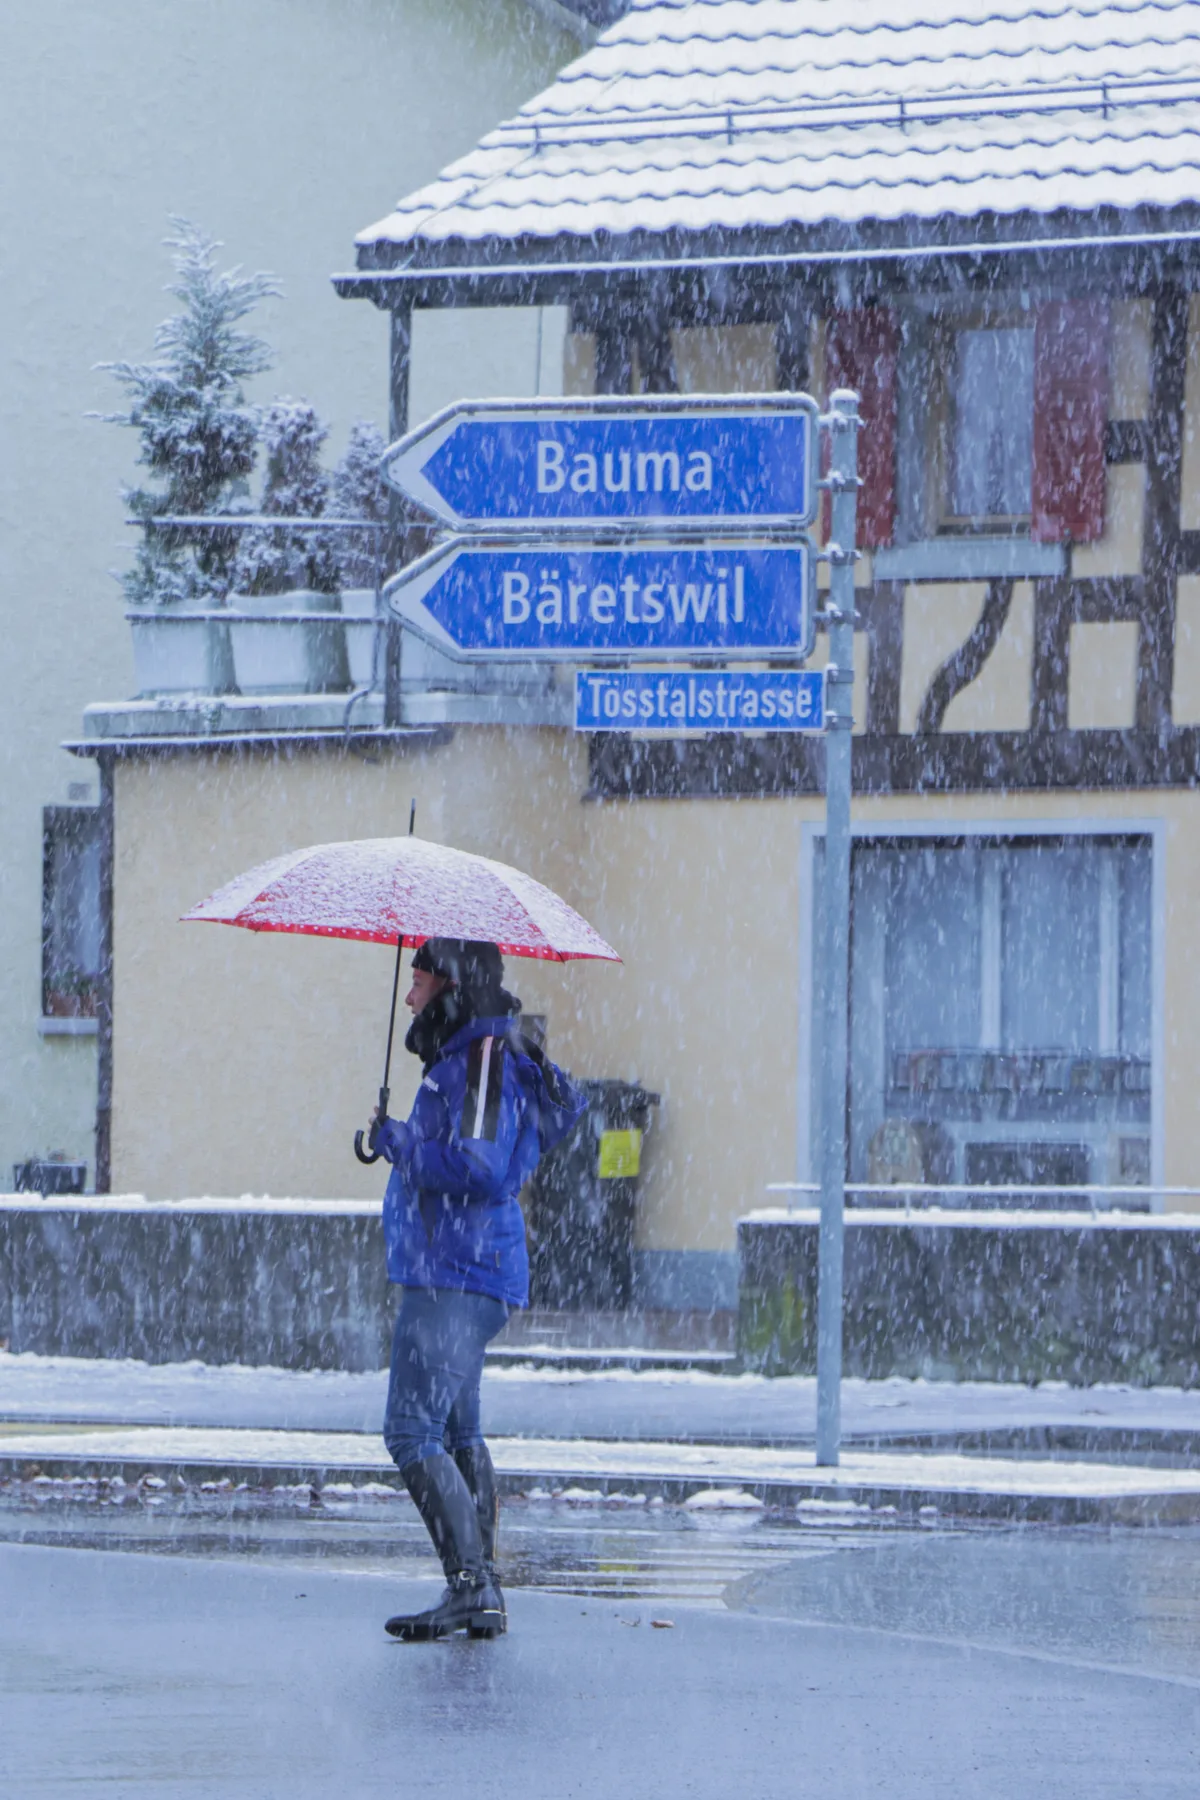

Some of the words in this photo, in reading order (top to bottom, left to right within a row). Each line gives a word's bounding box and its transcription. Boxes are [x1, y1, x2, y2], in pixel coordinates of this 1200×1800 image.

[536, 440, 713, 494] Bauma
[502, 565, 745, 624] Bäretswil
[587, 678, 813, 719] Tösstalstrasse
